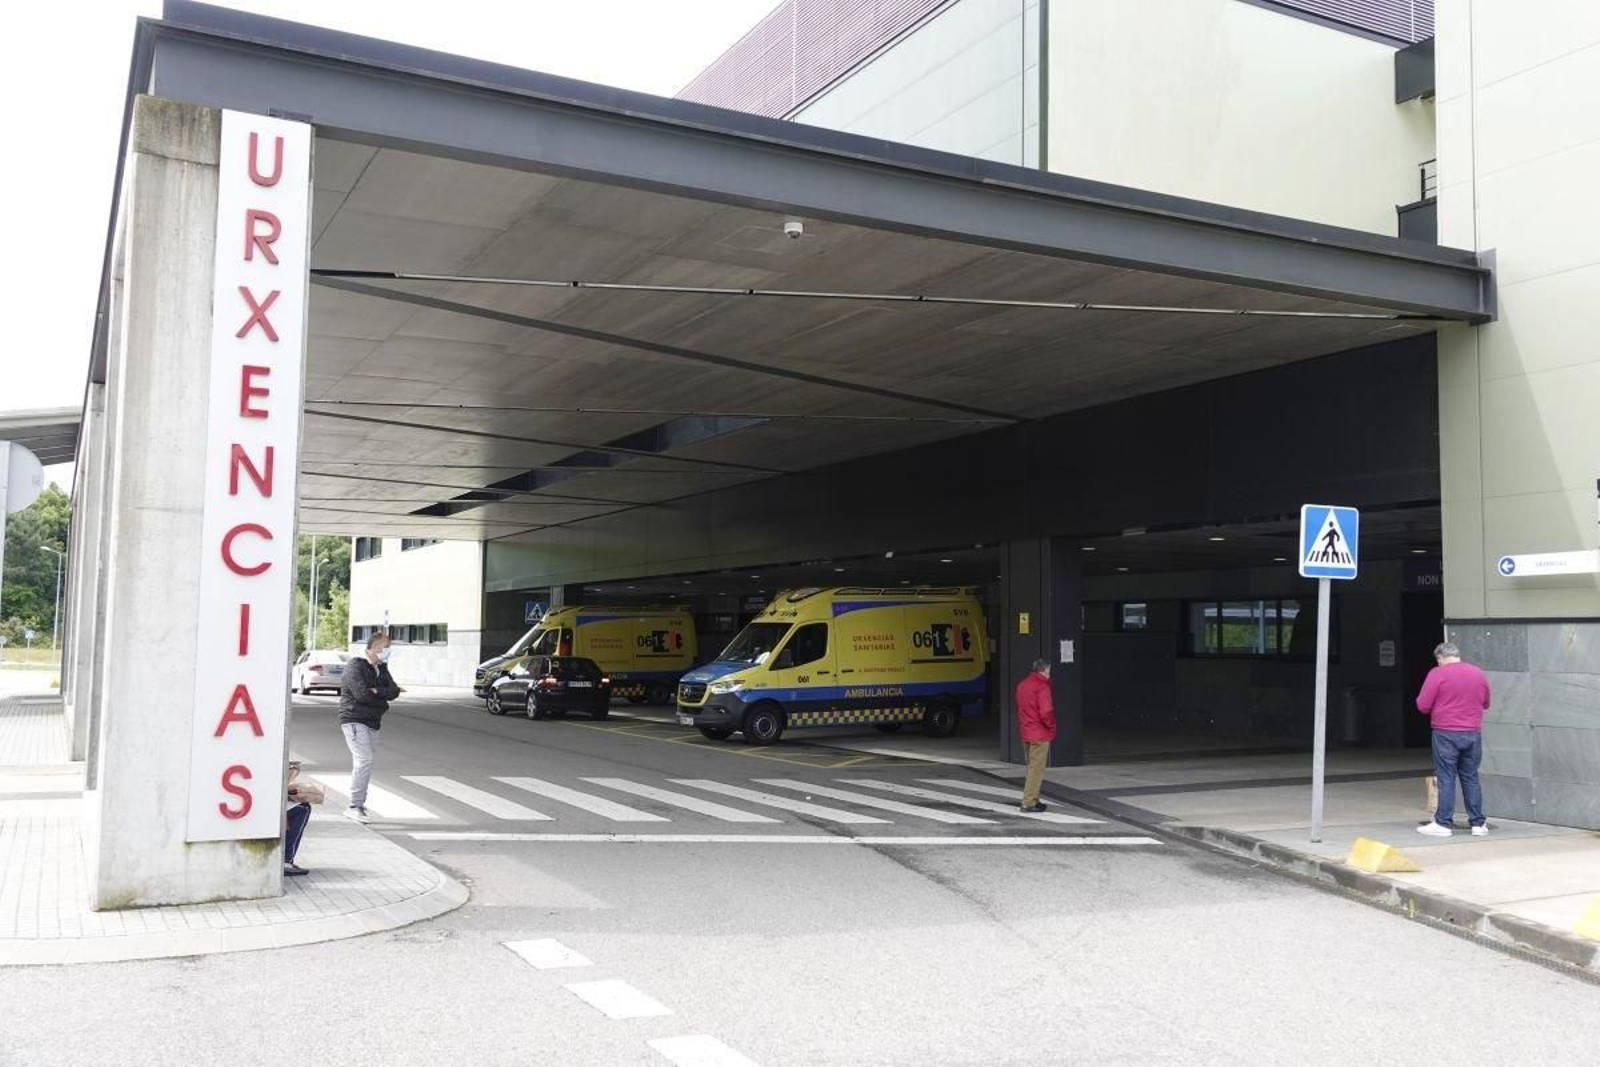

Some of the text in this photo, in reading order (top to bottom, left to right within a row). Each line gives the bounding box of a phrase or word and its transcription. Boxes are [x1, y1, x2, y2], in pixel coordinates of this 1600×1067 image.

[214, 132, 284, 820] URXENCIAS
[912, 630, 940, 648] 061
[844, 687, 903, 698] AMBULANCIA
